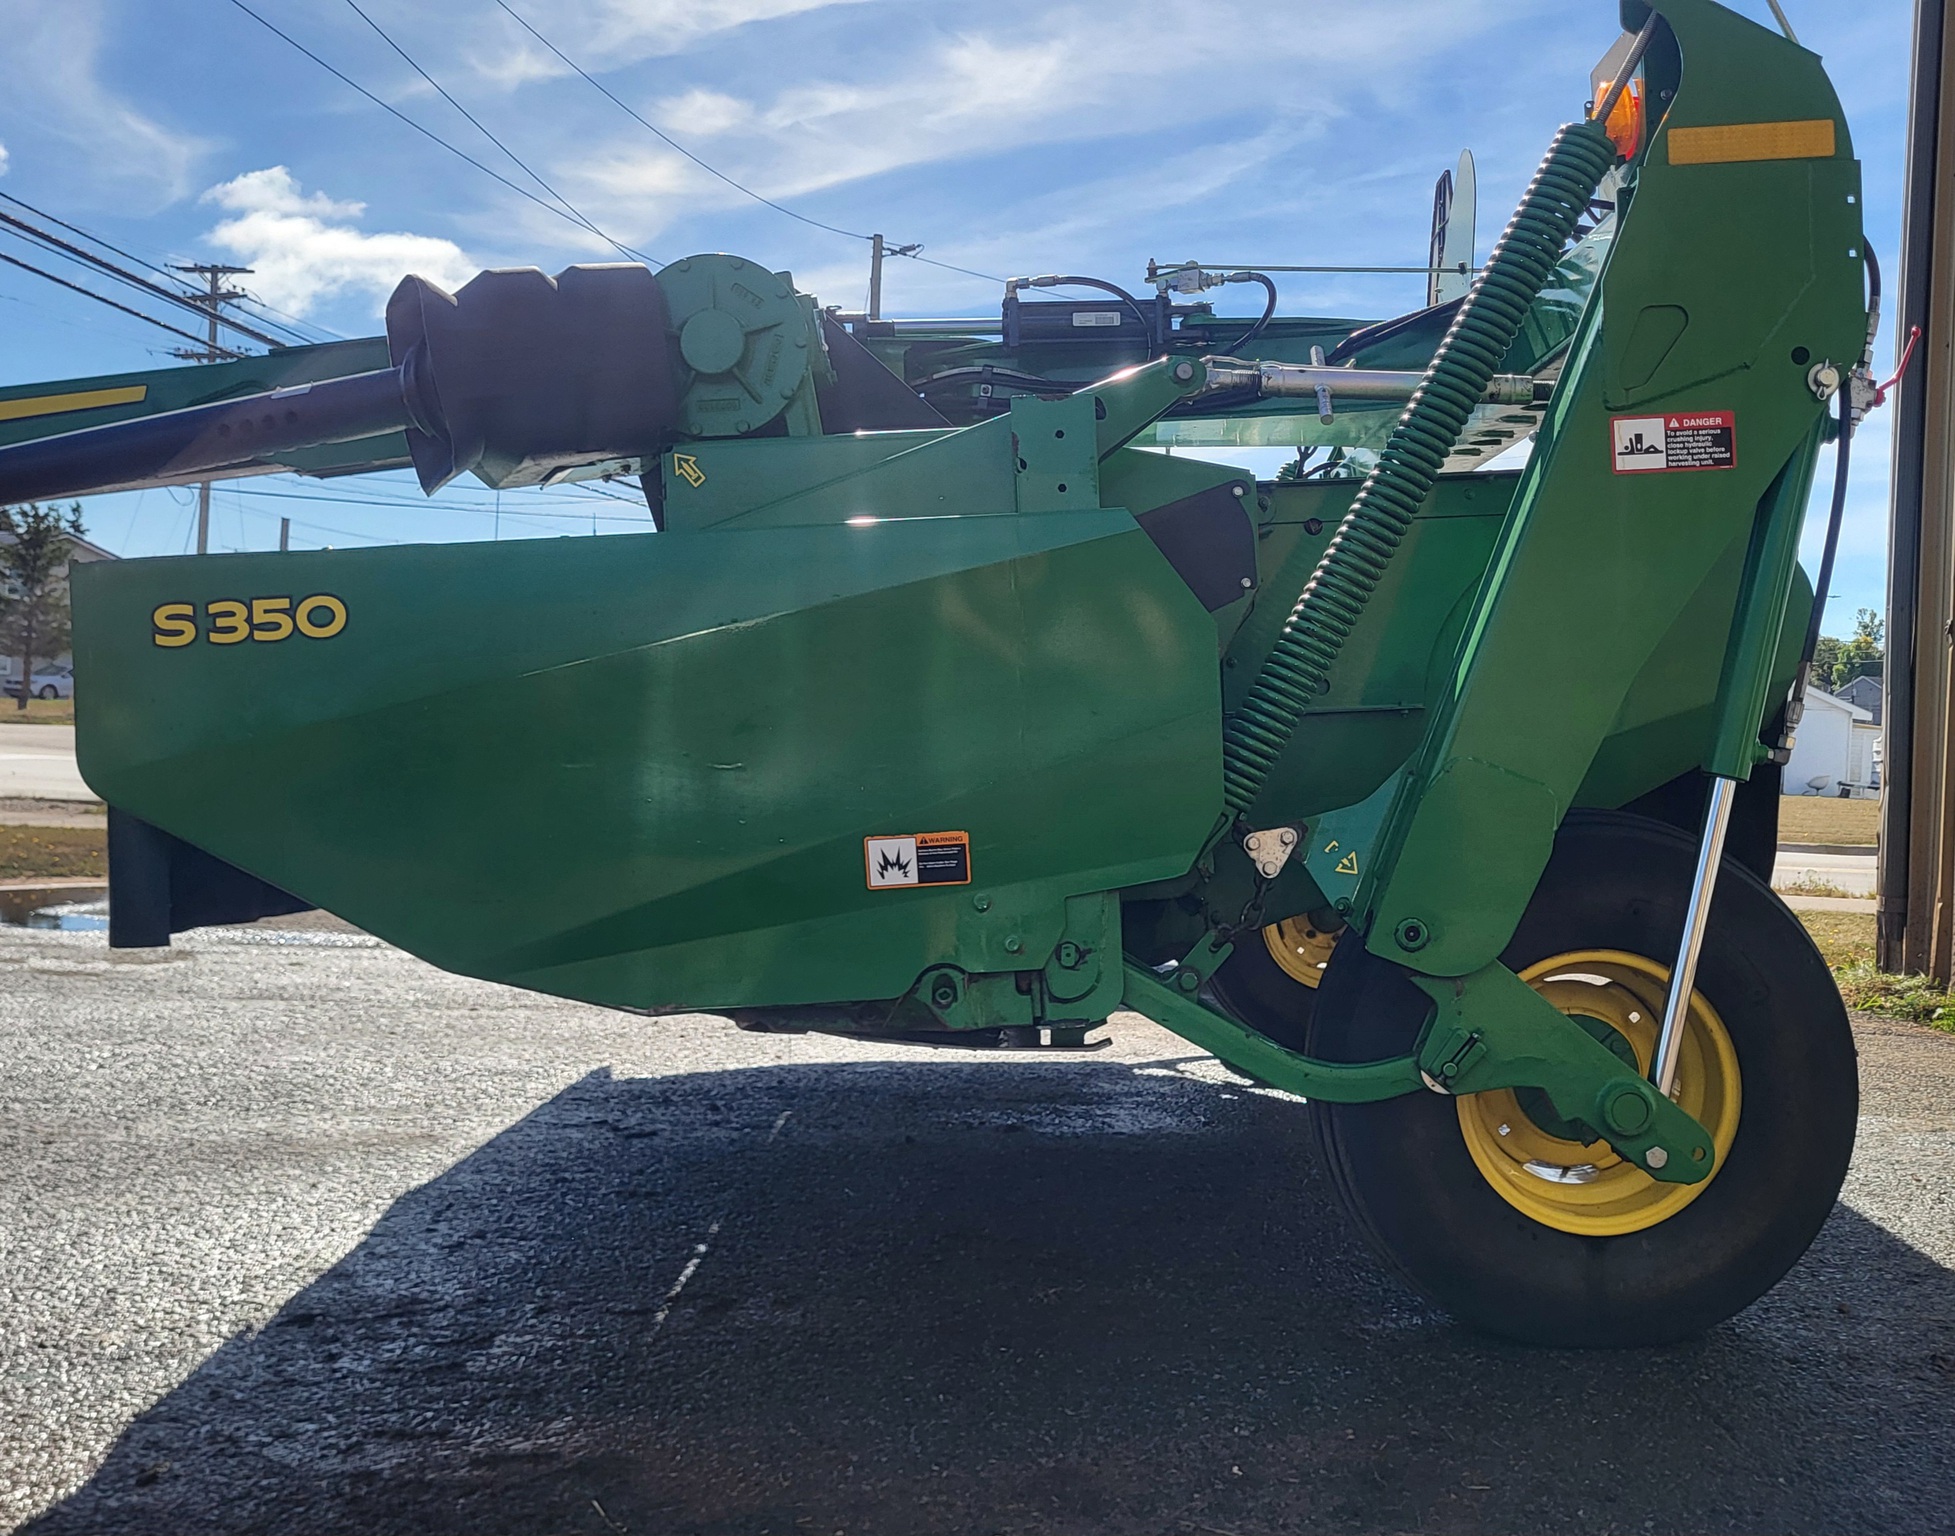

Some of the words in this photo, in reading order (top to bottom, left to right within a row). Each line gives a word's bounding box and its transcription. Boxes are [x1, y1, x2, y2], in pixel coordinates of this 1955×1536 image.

[1683, 417, 1722, 427] DANGER
[1668, 459, 1700, 467] harvesting
[153, 602, 197, 648] S
[206, 594, 348, 645] 350
